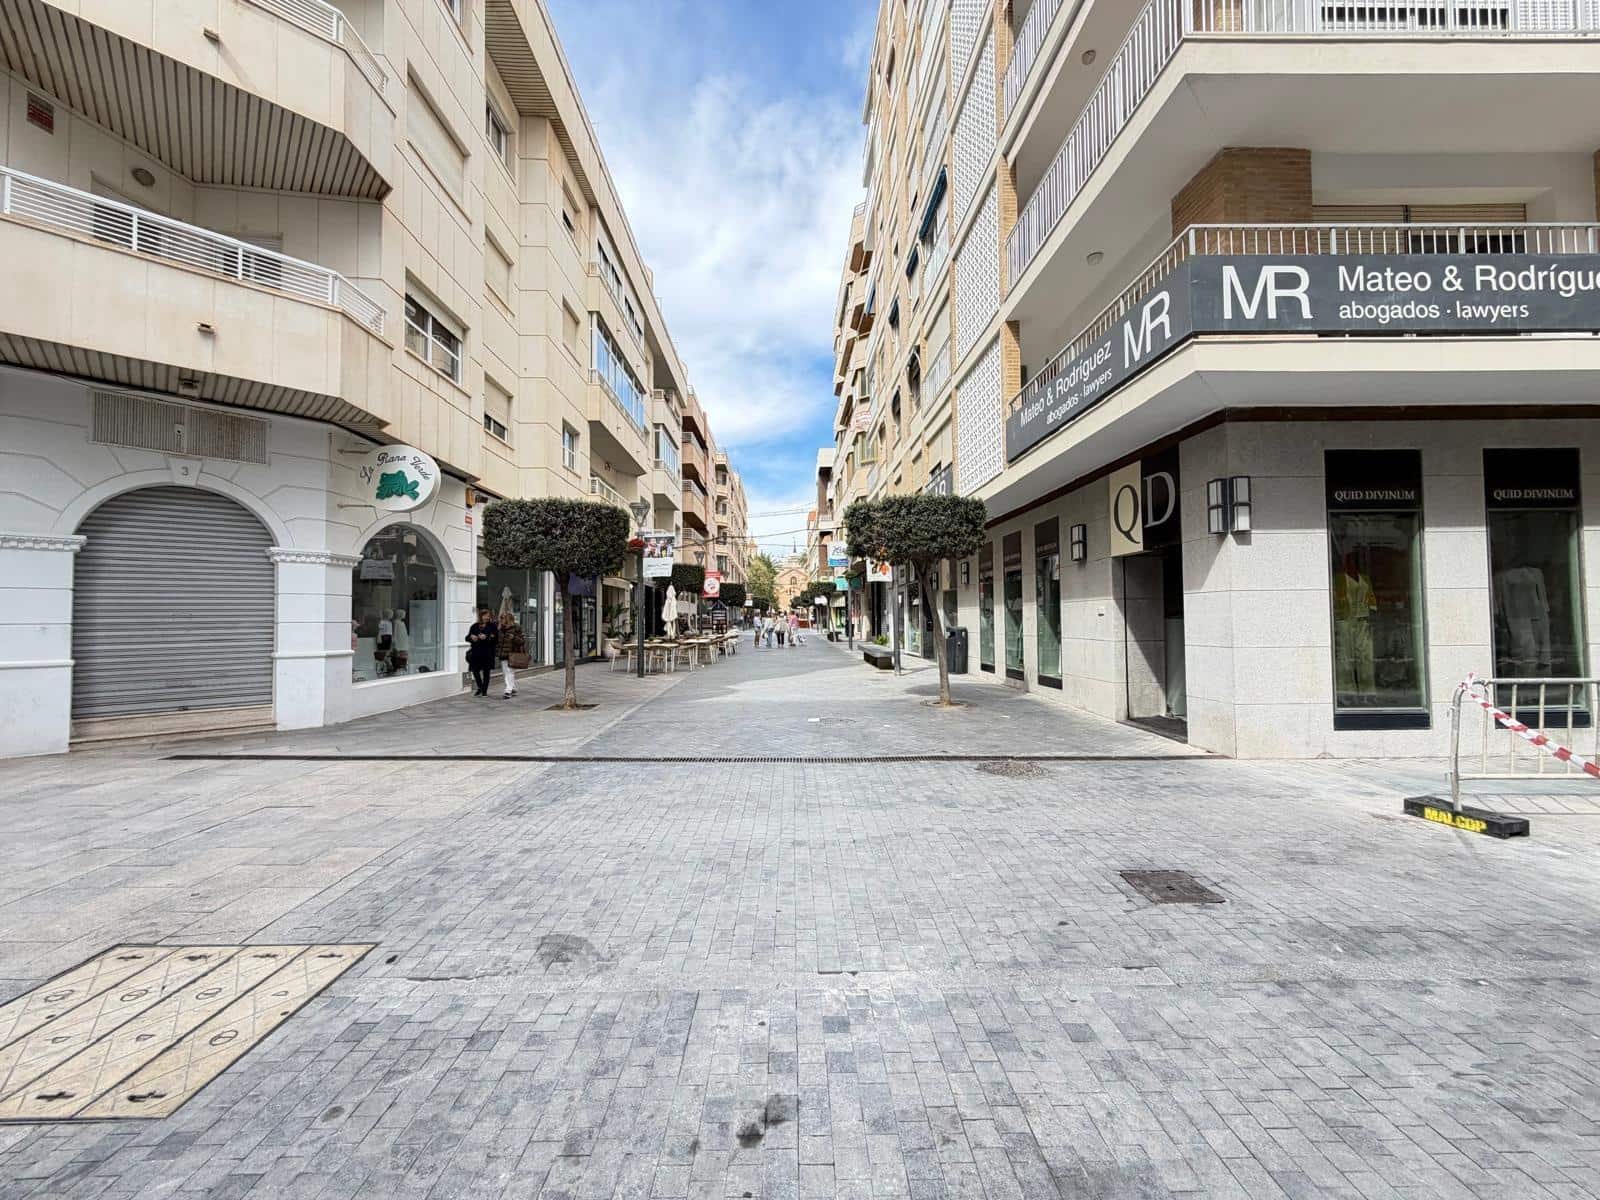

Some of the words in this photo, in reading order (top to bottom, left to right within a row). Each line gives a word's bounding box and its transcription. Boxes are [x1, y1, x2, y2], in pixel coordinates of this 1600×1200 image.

[1222, 265, 1313, 319] MR
[1338, 265, 1432, 292] Mateo
[1442, 265, 1464, 291] &
[1475, 264, 1600, 297] Rodrígu
[1339, 301, 1440, 324] abogados
[1456, 301, 1529, 323] lawyers
[1123, 290, 1172, 369] MR
[1020, 397, 1045, 428] Mateo
[1046, 387, 1054, 406] &
[1056, 340, 1112, 399] Rodríguez
[1046, 393, 1079, 425] abogados
[1083, 368, 1112, 398] lawyers
[377, 452, 406, 467] Rana
[409, 456, 432, 480] Verde
[1335, 490, 1363, 503] QUID
[1365, 490, 1415, 500] DIVINUM
[1494, 488, 1521, 501] QUID
[1523, 488, 1575, 499] DIVINUM
